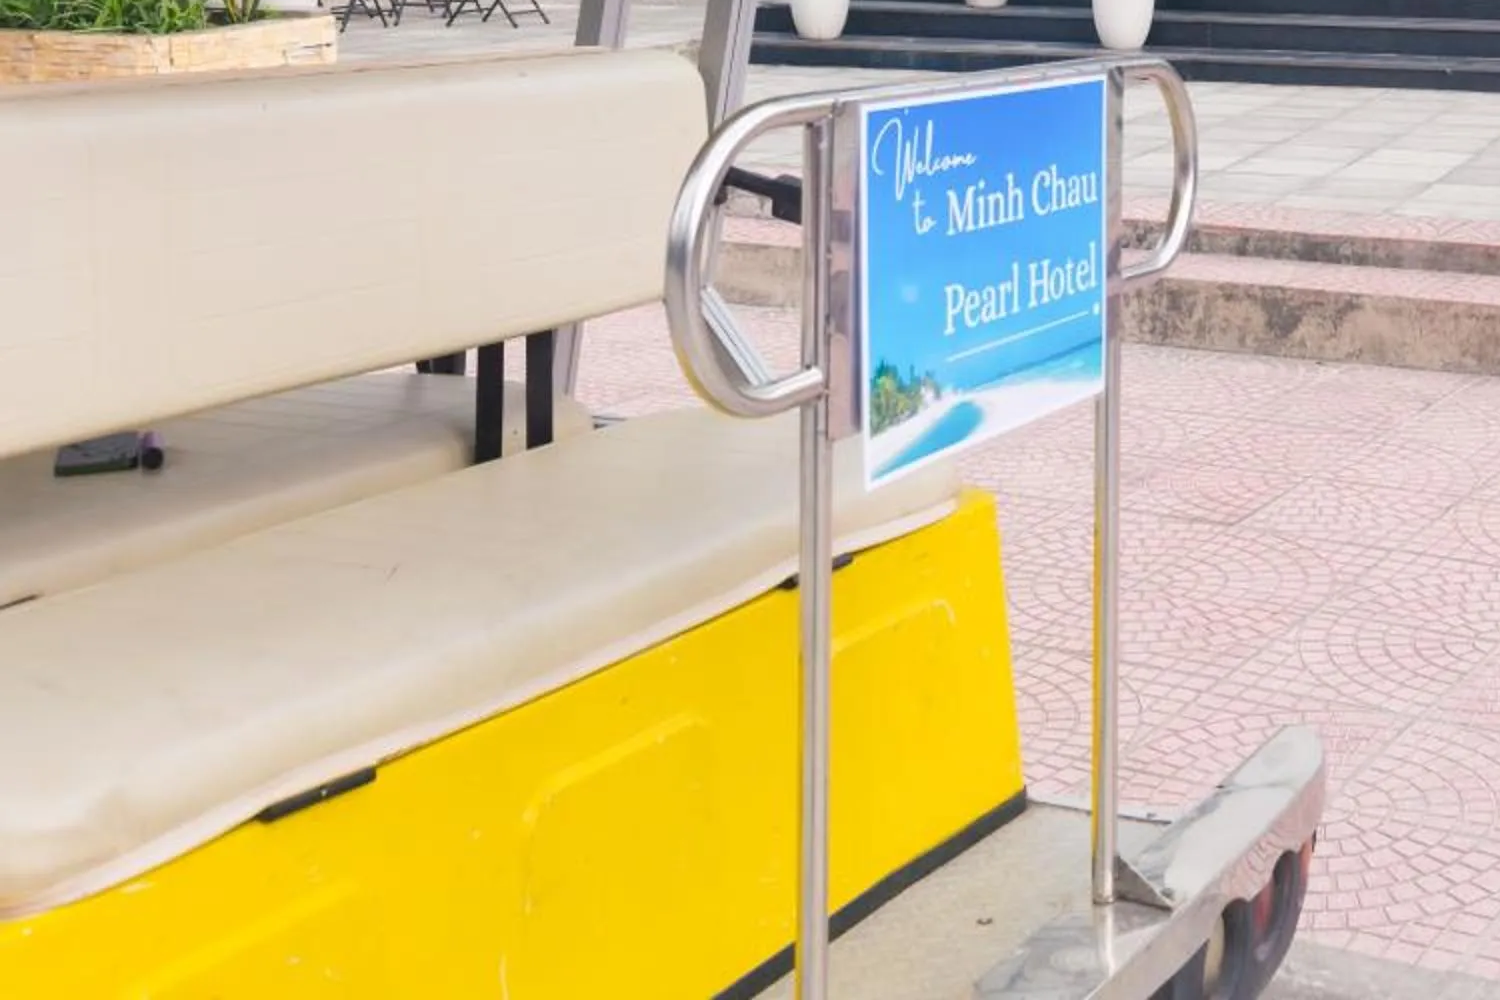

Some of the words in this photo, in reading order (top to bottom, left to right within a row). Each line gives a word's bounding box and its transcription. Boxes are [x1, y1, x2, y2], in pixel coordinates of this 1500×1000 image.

[871, 117, 976, 201] Welcome
[913, 190, 937, 236] to
[946, 172, 1024, 236] Minh
[1031, 163, 1099, 216] Chau
[943, 262, 1021, 336] Pearl
[1028, 241, 1098, 309] Hotel
